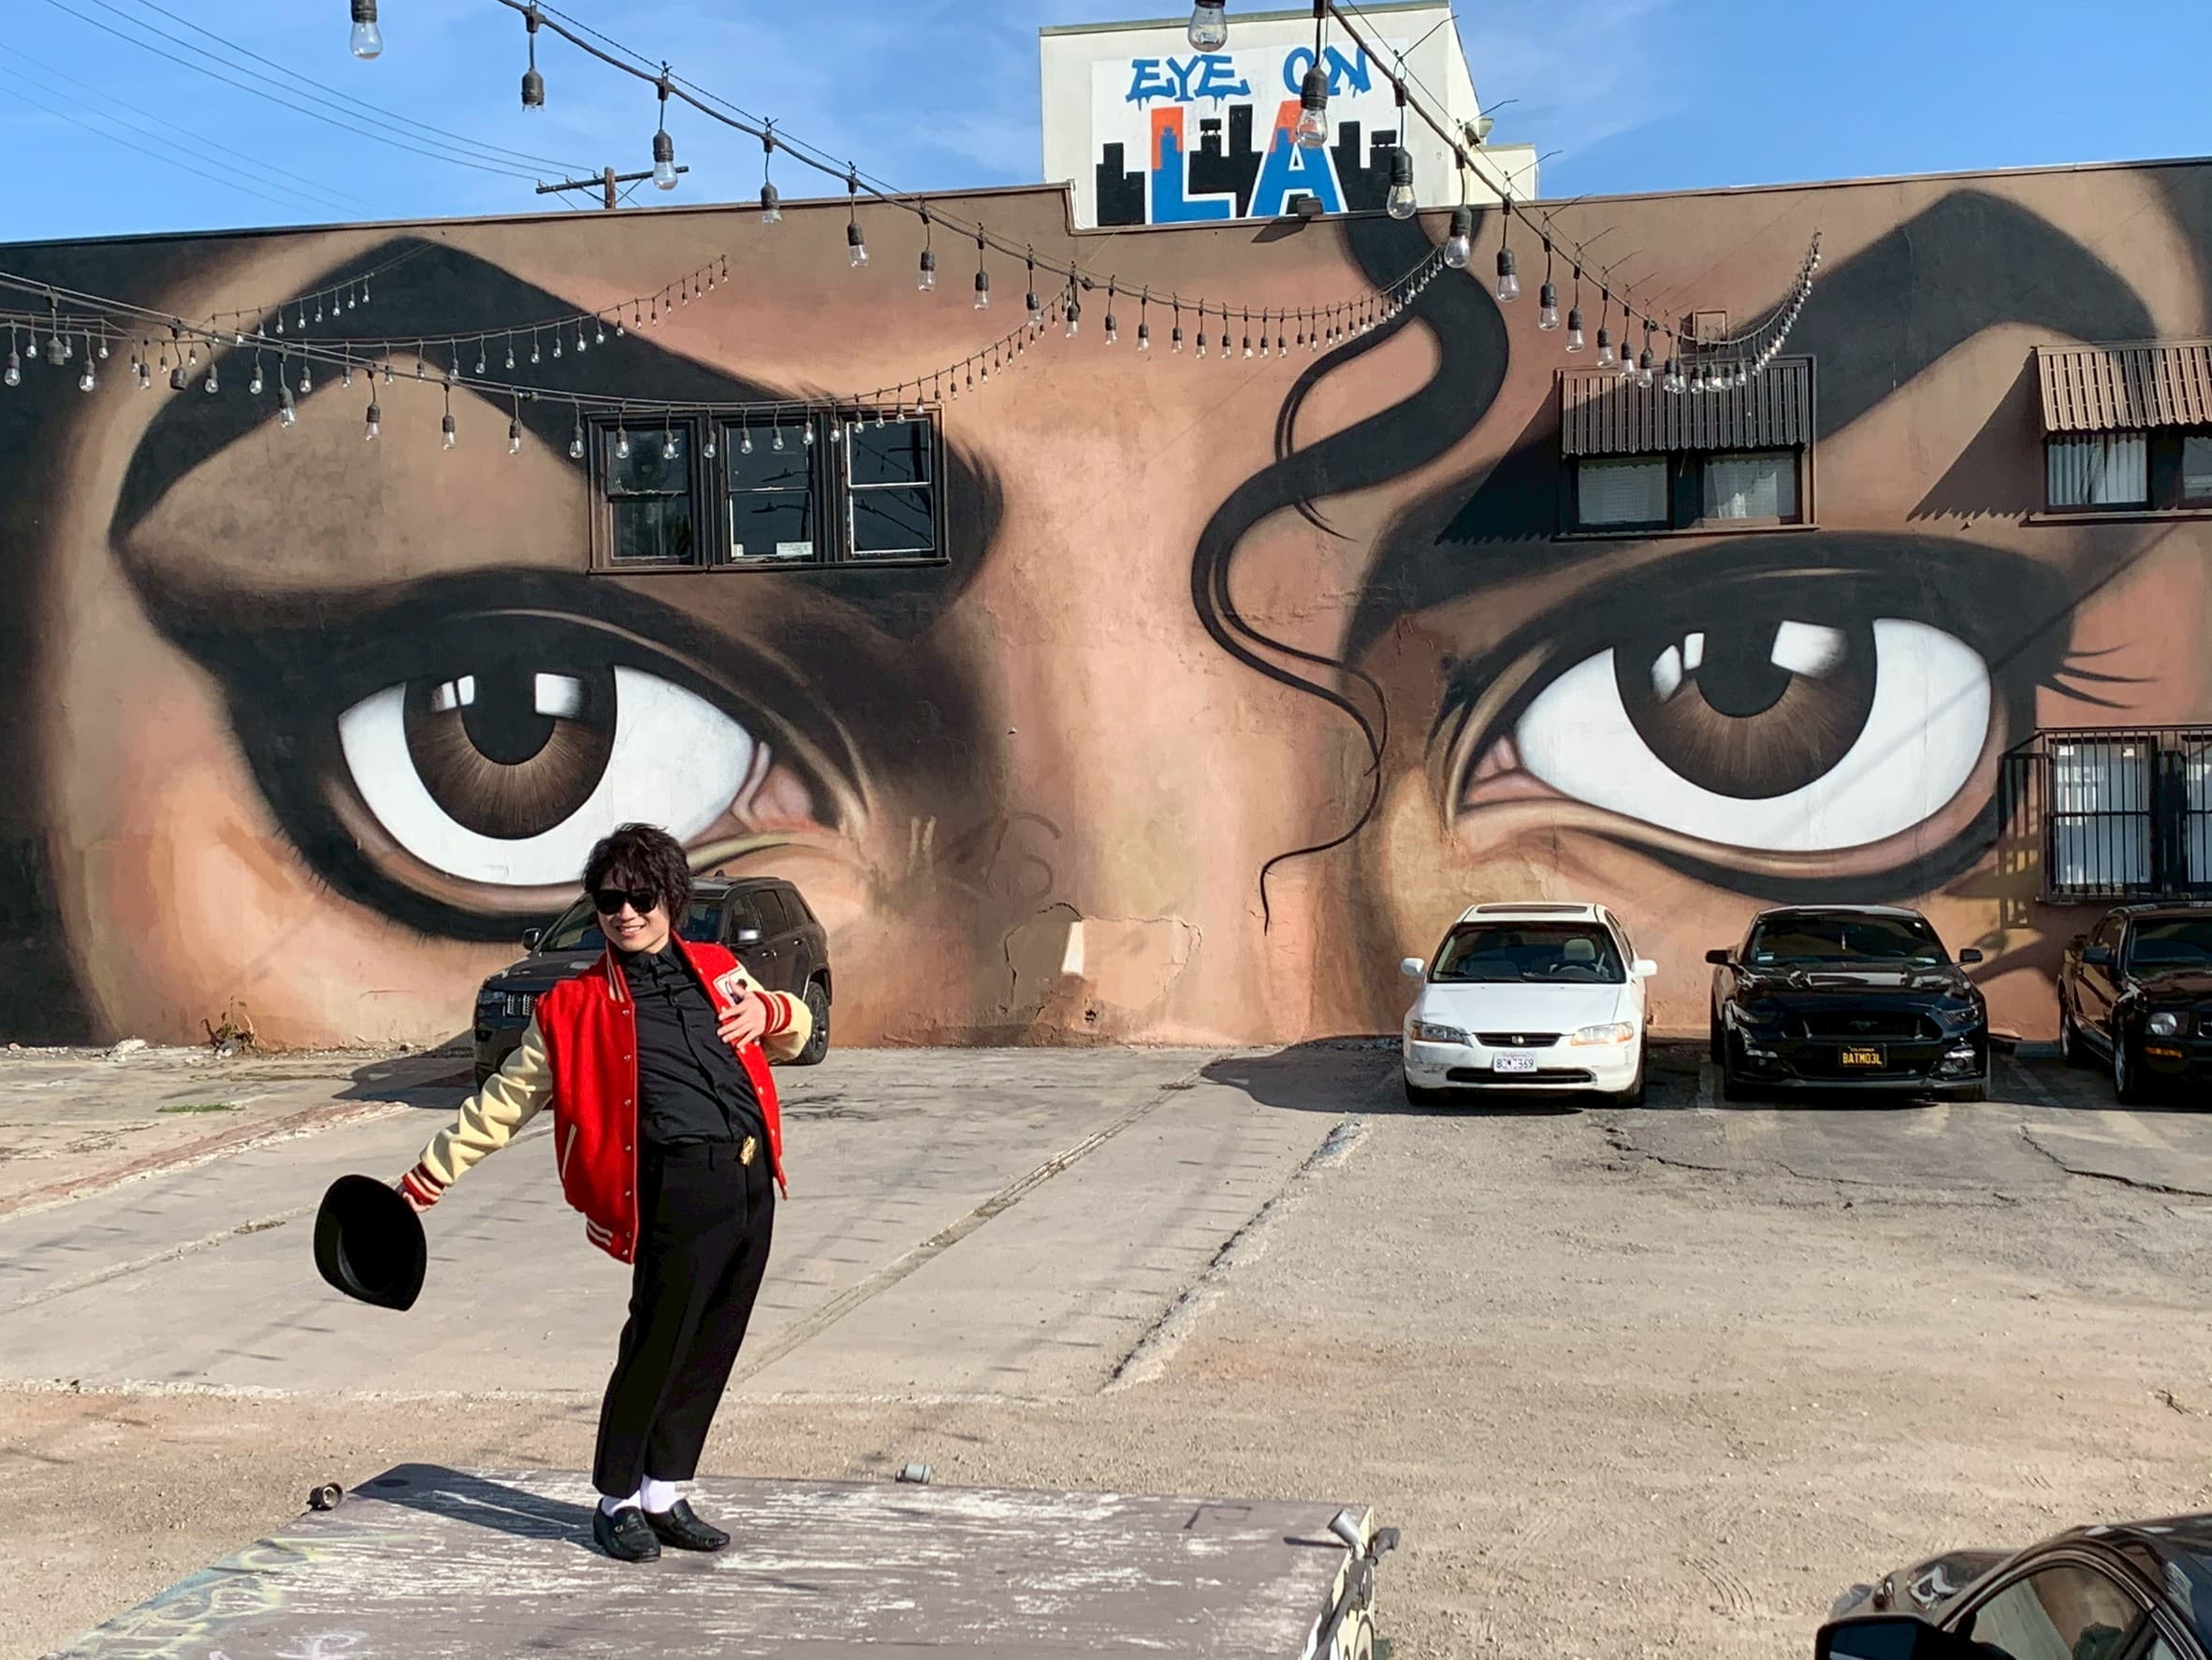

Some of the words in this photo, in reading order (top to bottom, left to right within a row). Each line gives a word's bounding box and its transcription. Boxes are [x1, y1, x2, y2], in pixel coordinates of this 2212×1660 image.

[1126, 54, 1252, 110] EYE
[1283, 45, 1373, 98] ON
[1151, 99, 1342, 225] LA
